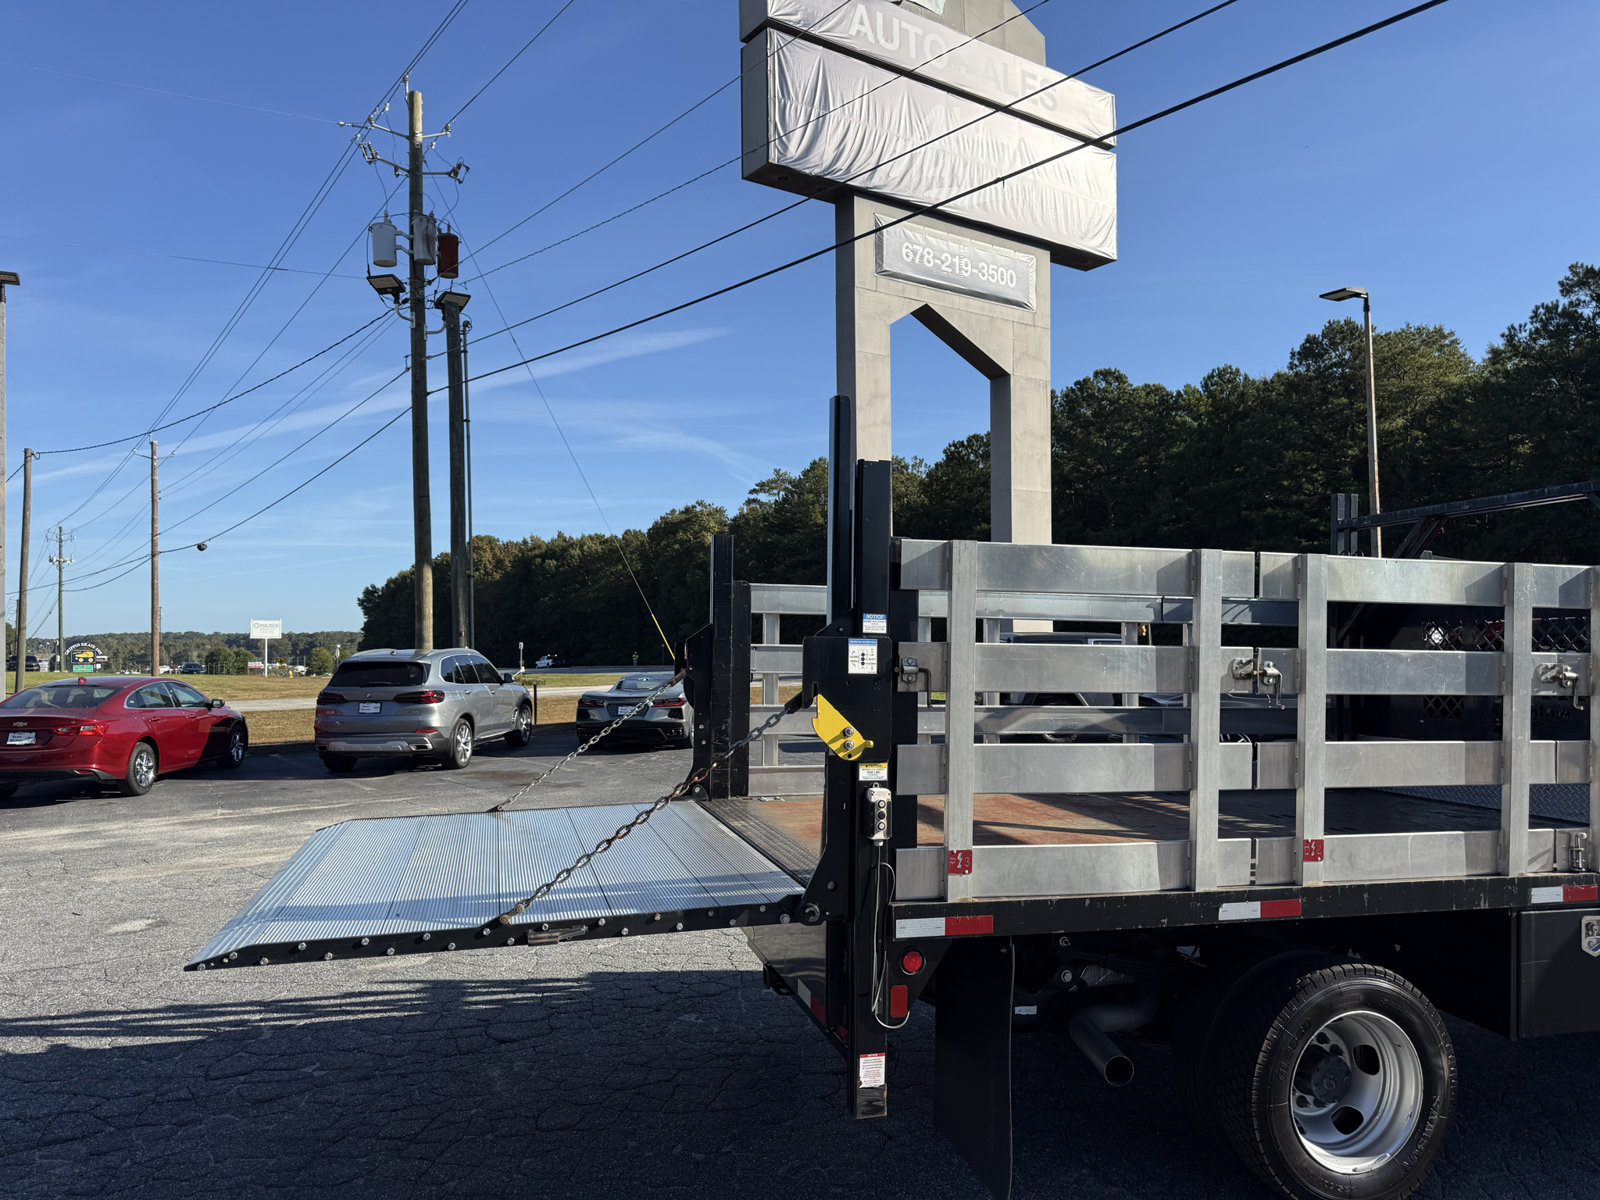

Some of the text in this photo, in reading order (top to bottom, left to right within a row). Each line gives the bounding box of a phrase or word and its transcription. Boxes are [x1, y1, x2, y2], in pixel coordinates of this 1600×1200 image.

[849, 3, 1059, 112] AUTO ALES
[902, 242, 1017, 287] 678-219-3500
